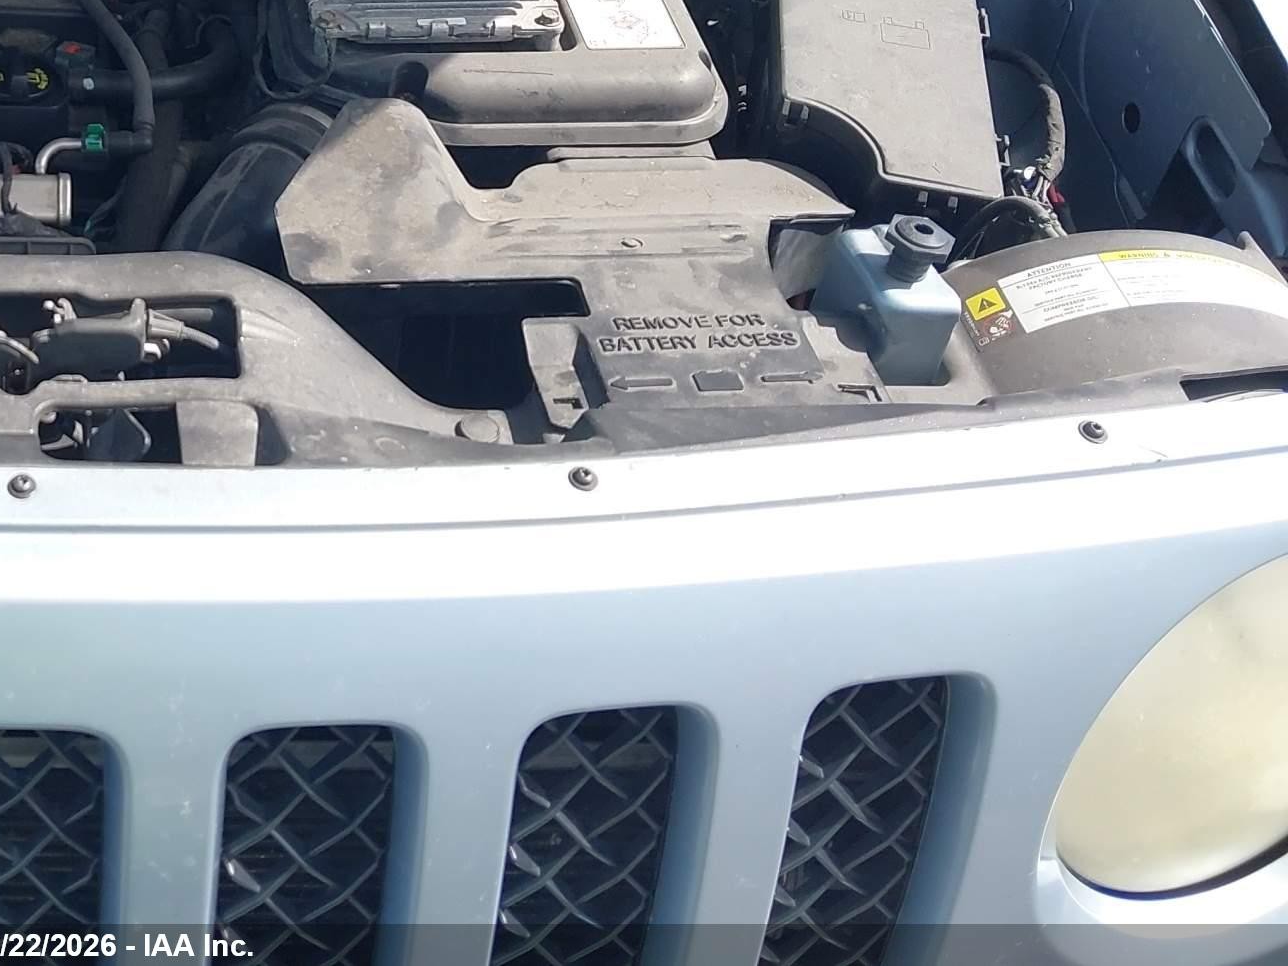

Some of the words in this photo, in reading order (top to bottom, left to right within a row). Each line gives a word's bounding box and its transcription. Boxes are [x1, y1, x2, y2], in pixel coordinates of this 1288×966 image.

[1027, 262, 1071, 278] ATTENTION
[612, 315, 712, 331] REMOVE
[715, 314, 765, 328] FOR
[598, 334, 697, 353] BATTERY
[708, 332, 798, 349] ACCESS
